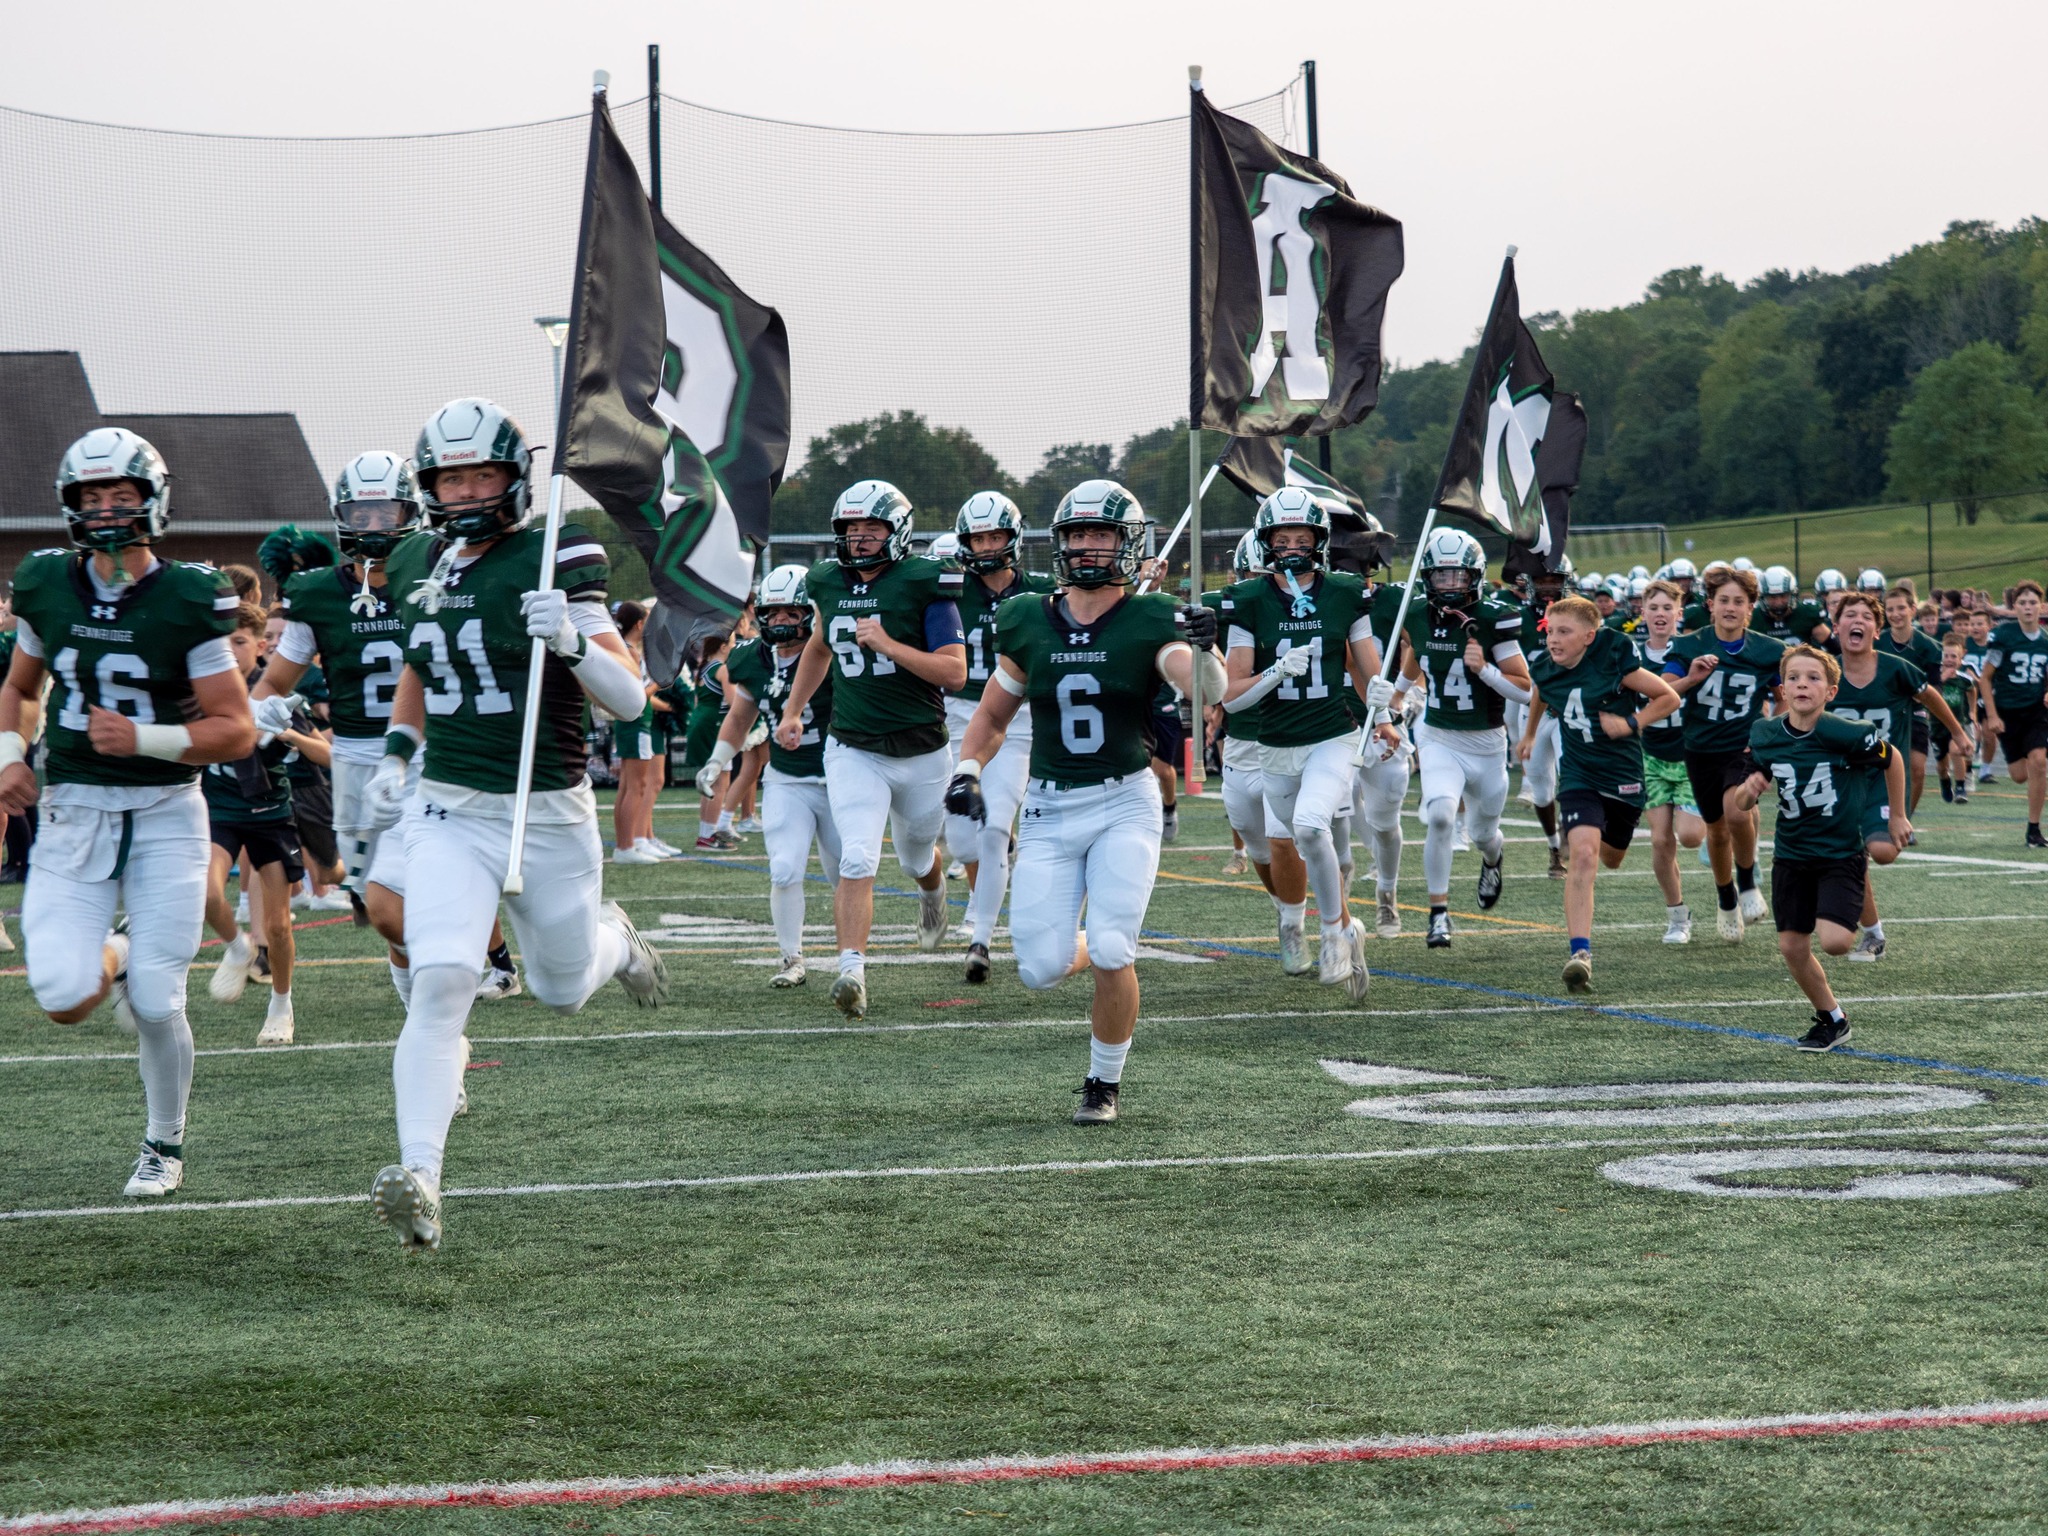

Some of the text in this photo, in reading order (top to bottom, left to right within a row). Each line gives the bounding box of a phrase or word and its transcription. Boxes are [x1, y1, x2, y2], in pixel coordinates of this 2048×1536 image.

[441, 451, 478, 462] Riddell
[357, 489, 388, 497] Riddell
[838, 598, 878, 609] PENNRIDGE
[1278, 619, 1323, 631] PENNRIDGE
[408, 618, 514, 716] 31
[1050, 651, 1107, 664] PENNRIDGE
[1276, 636, 1328, 700] 11
[1425, 641, 1458, 652] PENNRIDGE
[54, 646, 156, 732] 16
[1419, 655, 1474, 711] 14
[1696, 670, 1757, 721] 43
[1056, 673, 1105, 754] 6
[1564, 688, 1594, 743] 4
[1770, 762, 1838, 819] 34
